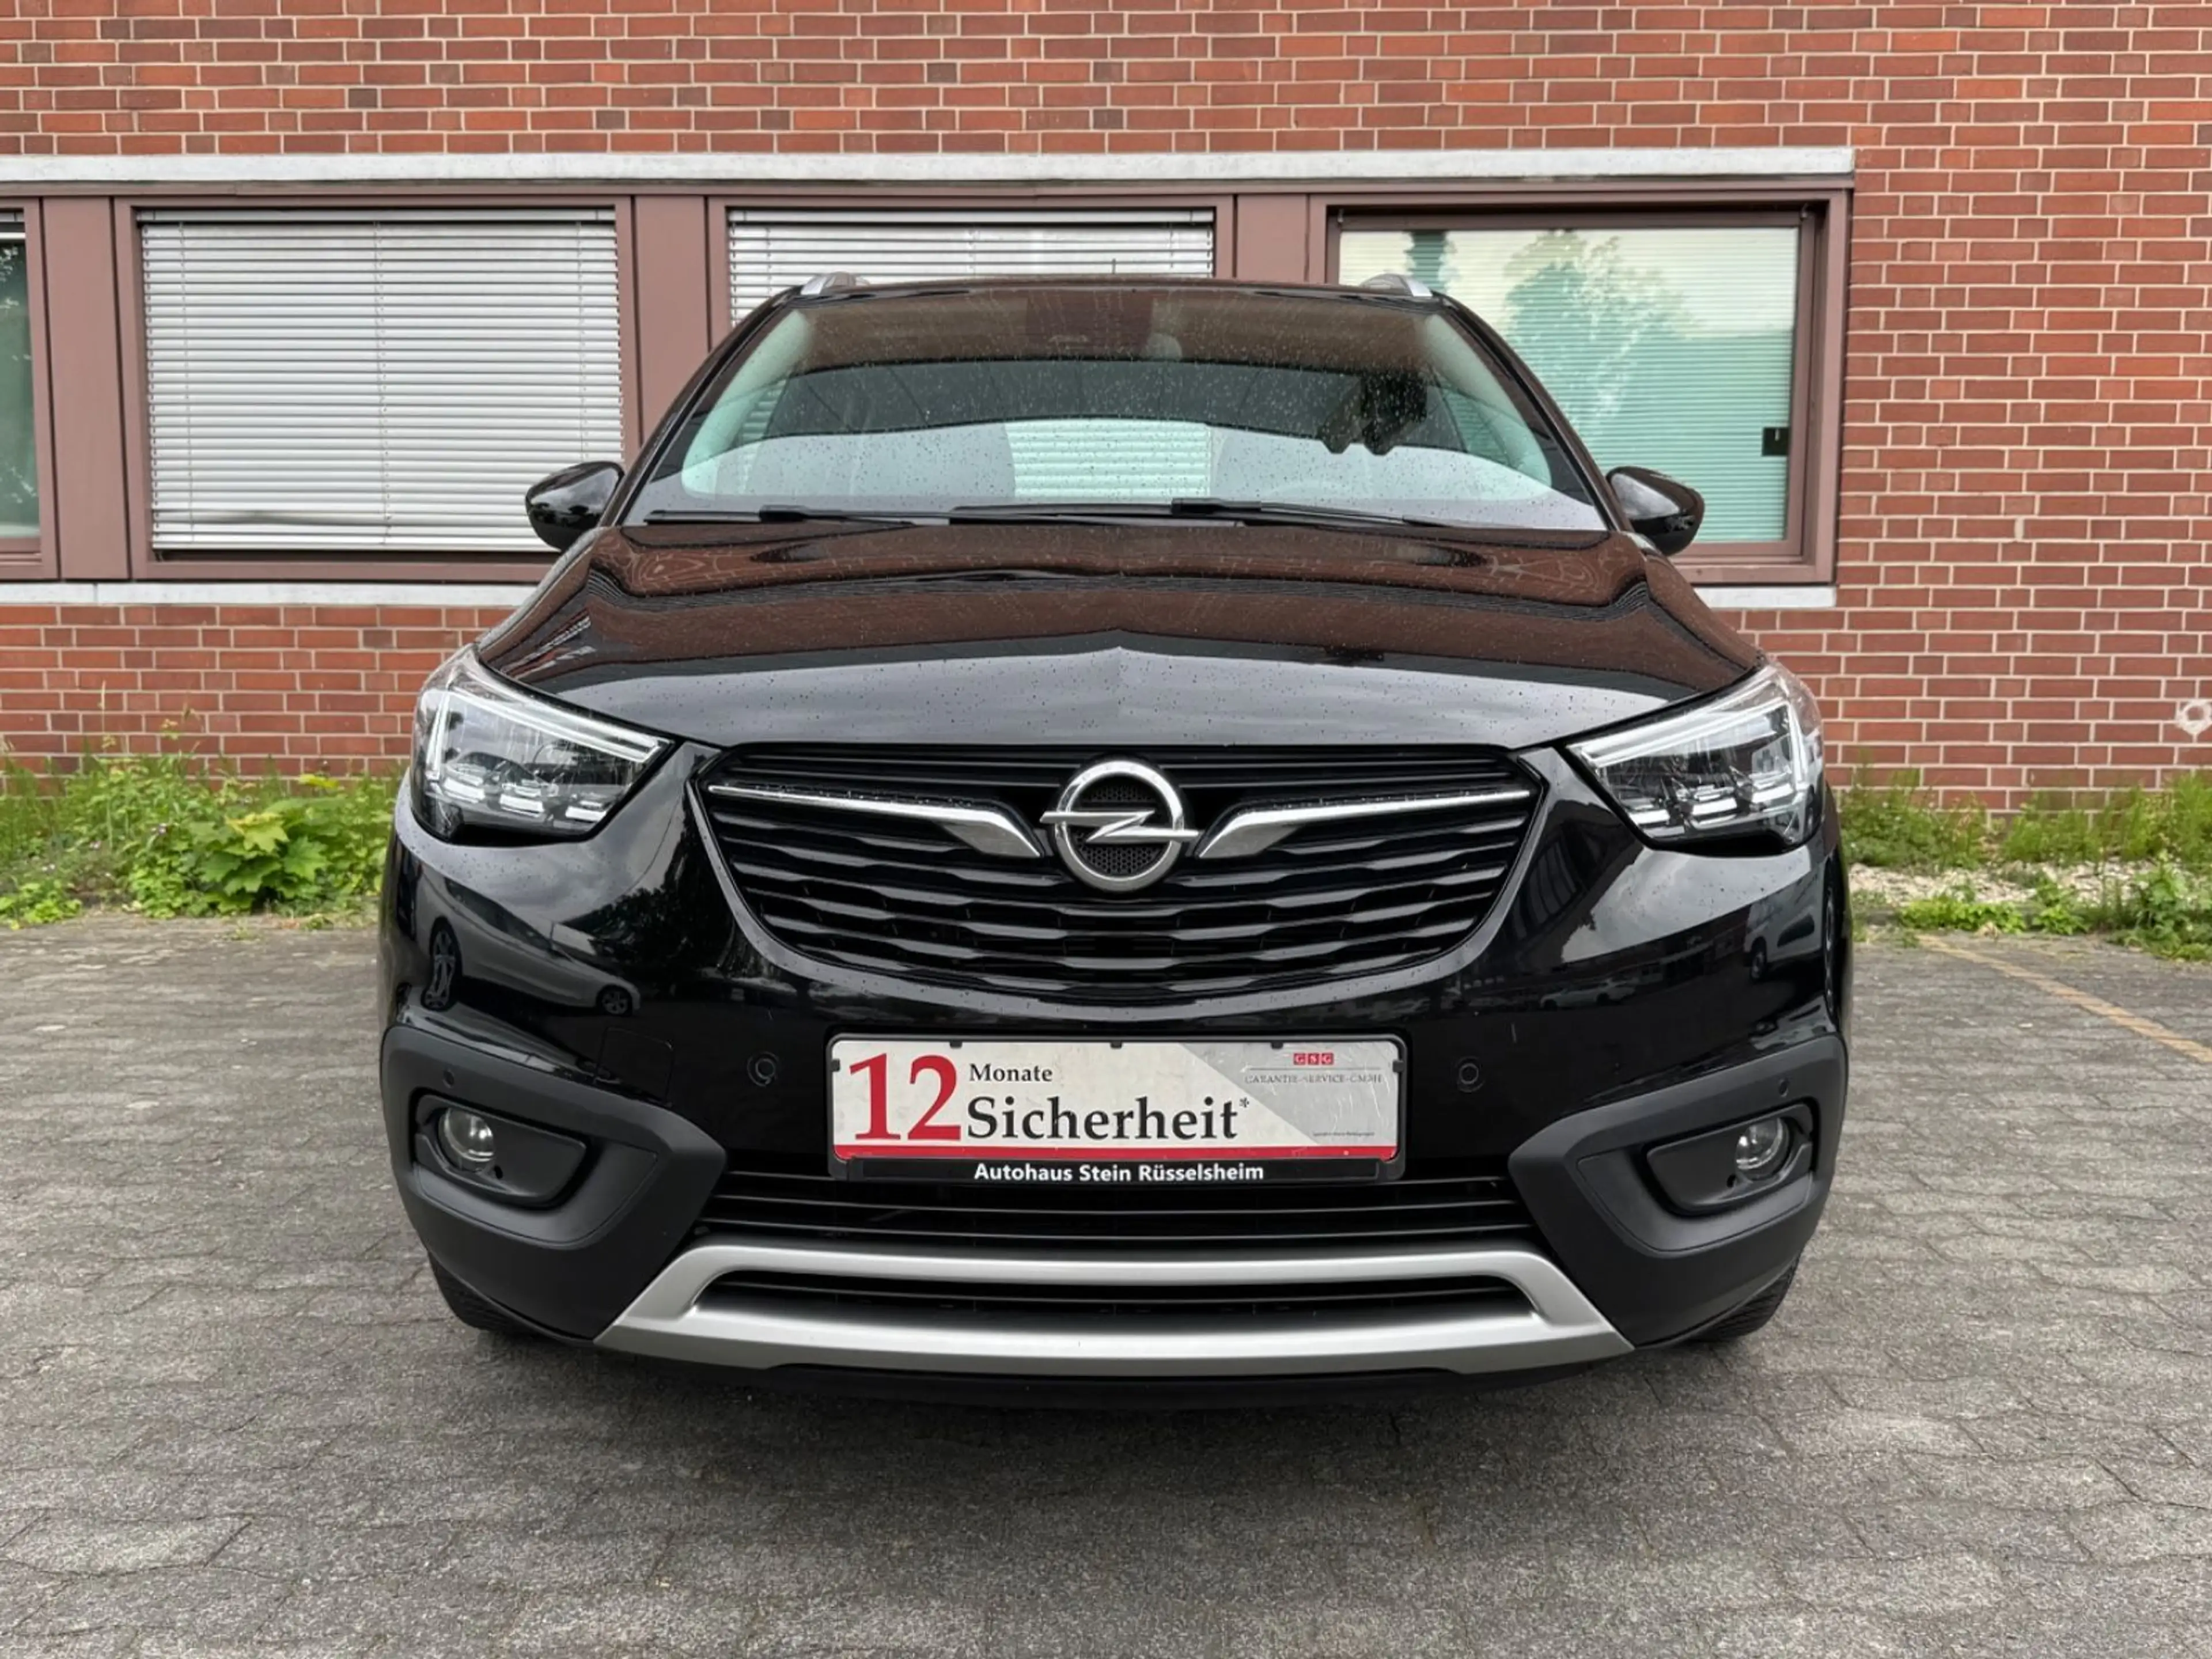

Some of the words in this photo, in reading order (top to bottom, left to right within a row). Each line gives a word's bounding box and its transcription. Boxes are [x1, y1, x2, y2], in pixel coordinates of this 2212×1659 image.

[1294, 1053, 1334, 1065] GSG
[970, 1063, 1052, 1082] Monate
[850, 1054, 961, 1141] 12
[974, 1162, 1073, 1182] Autohaus
[1078, 1163, 1132, 1182] Stein
[1138, 1162, 1264, 1182] Rüsselsheim
